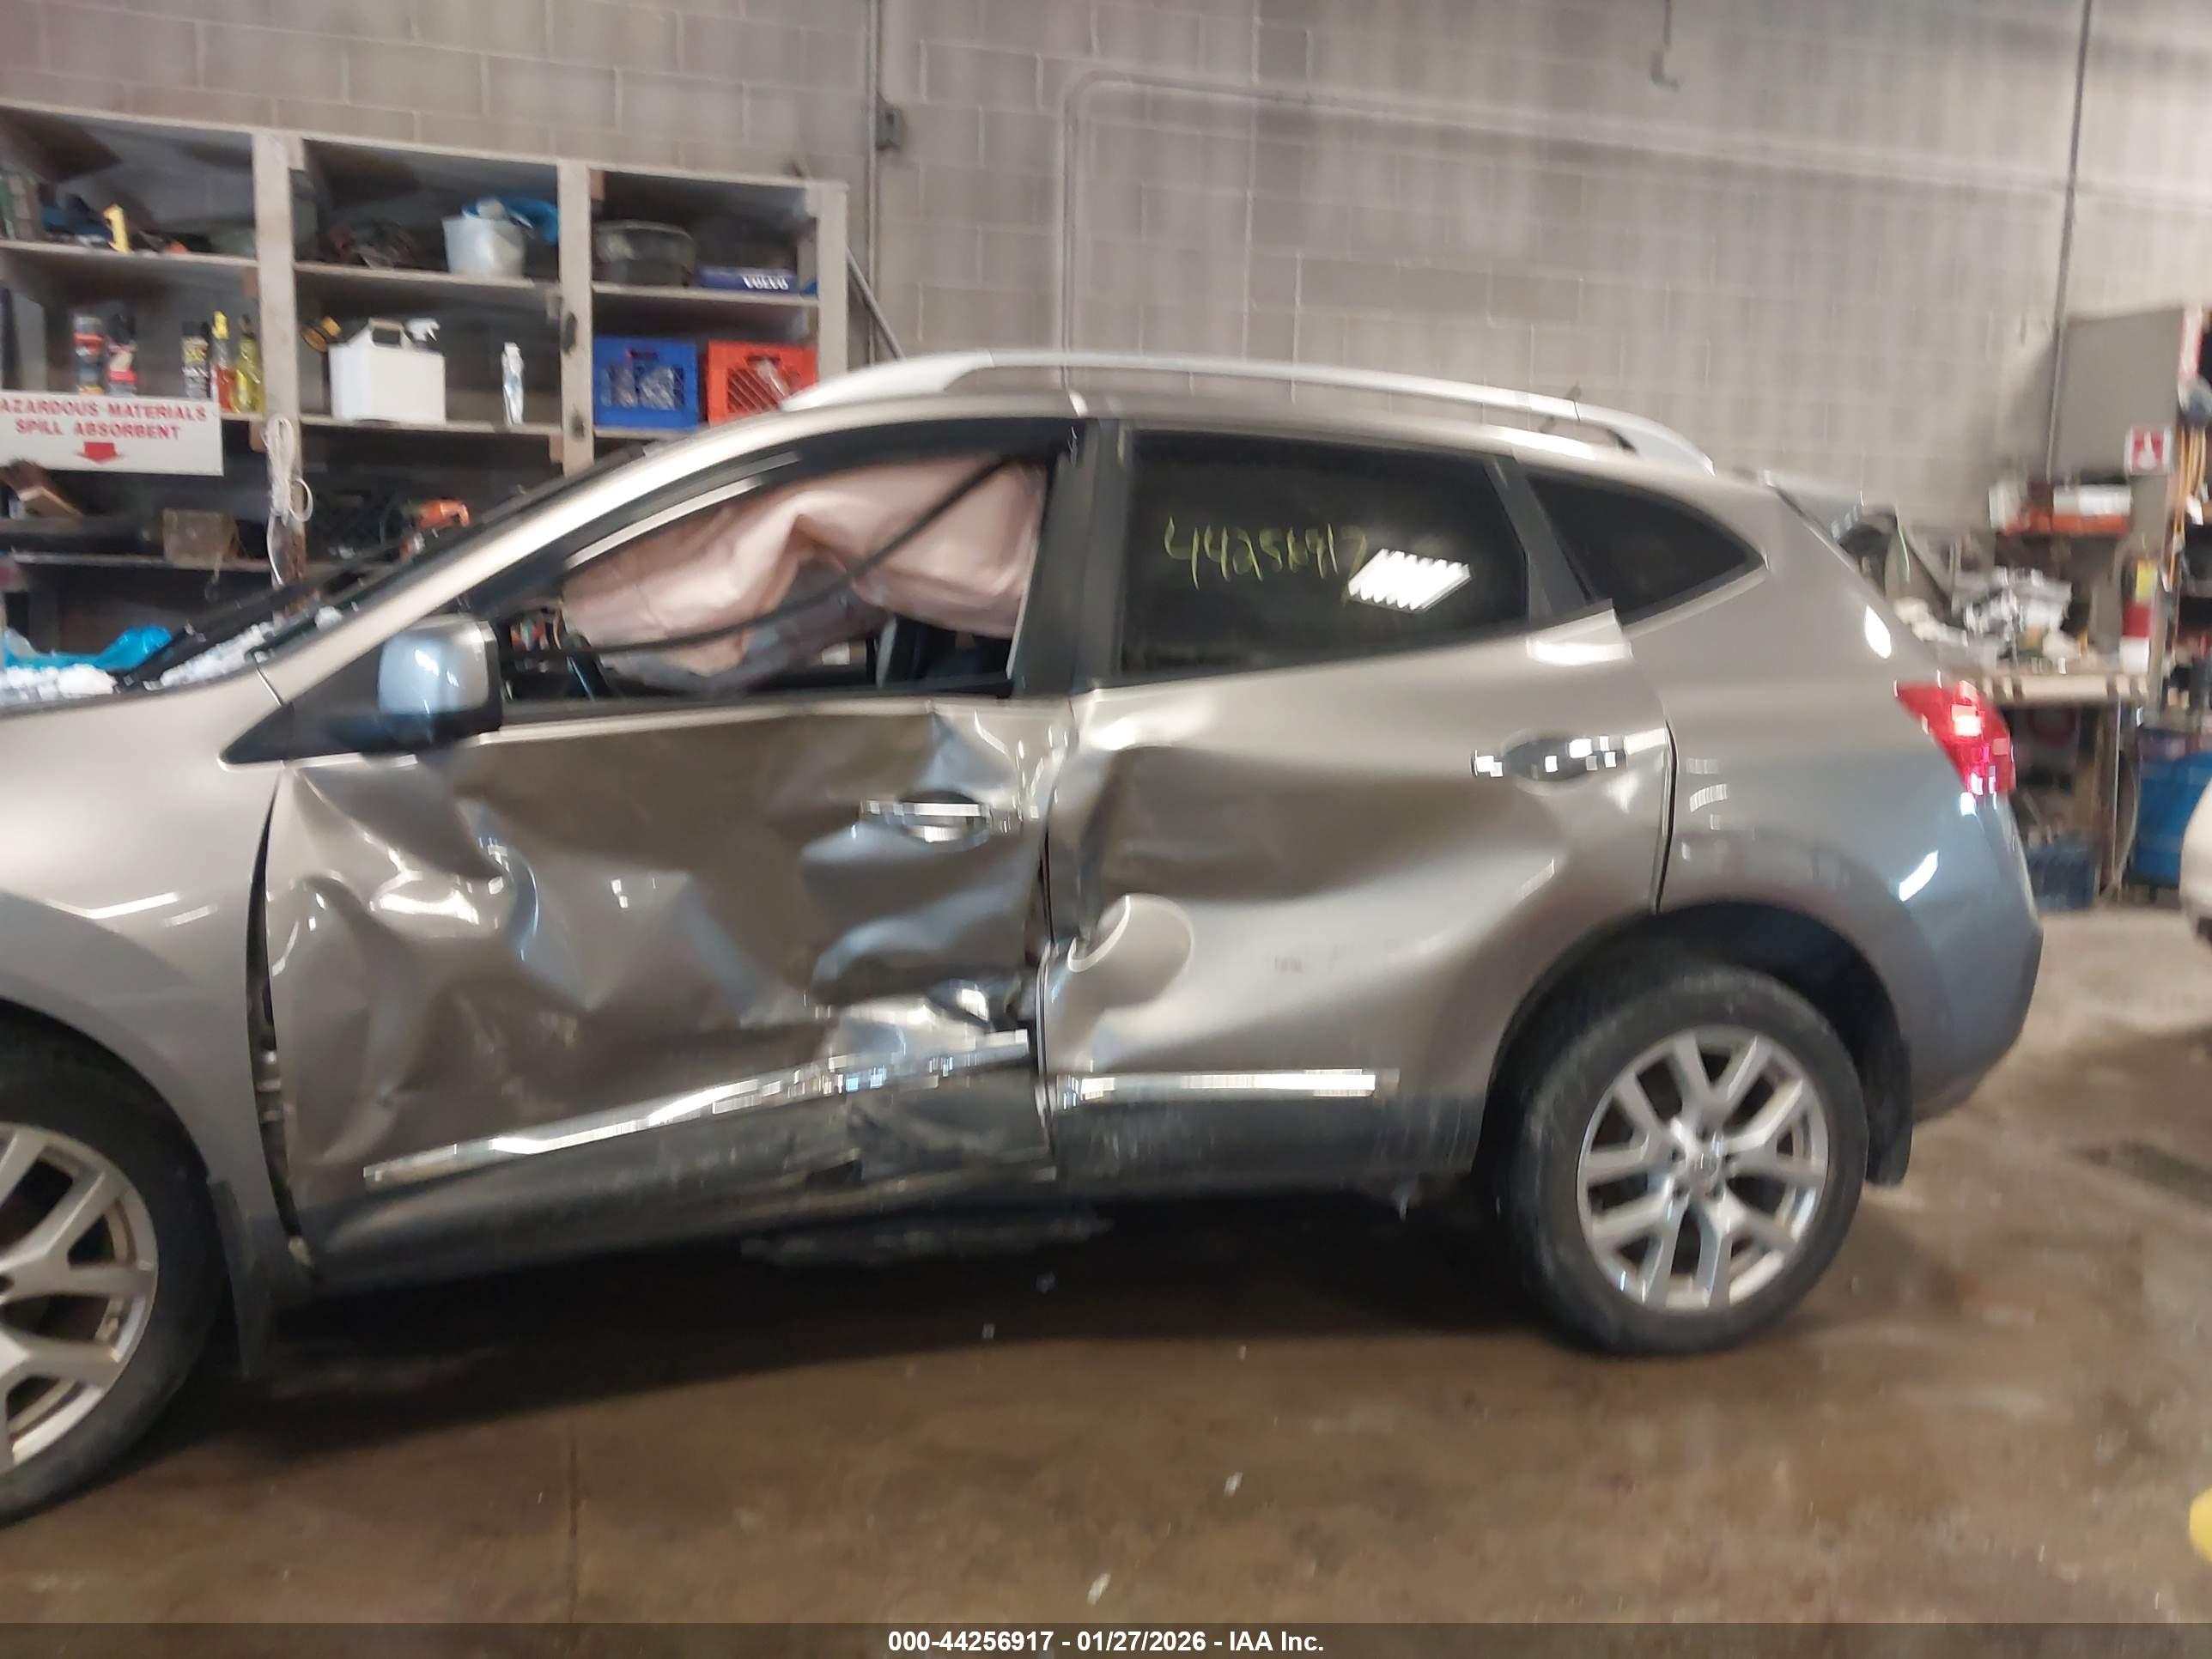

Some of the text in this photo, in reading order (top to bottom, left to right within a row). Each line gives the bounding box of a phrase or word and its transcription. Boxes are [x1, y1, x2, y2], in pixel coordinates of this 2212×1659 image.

[0, 398, 207, 422] AZARDOUS MATERIALS
[15, 419, 181, 441] SPILL ABSORBENT
